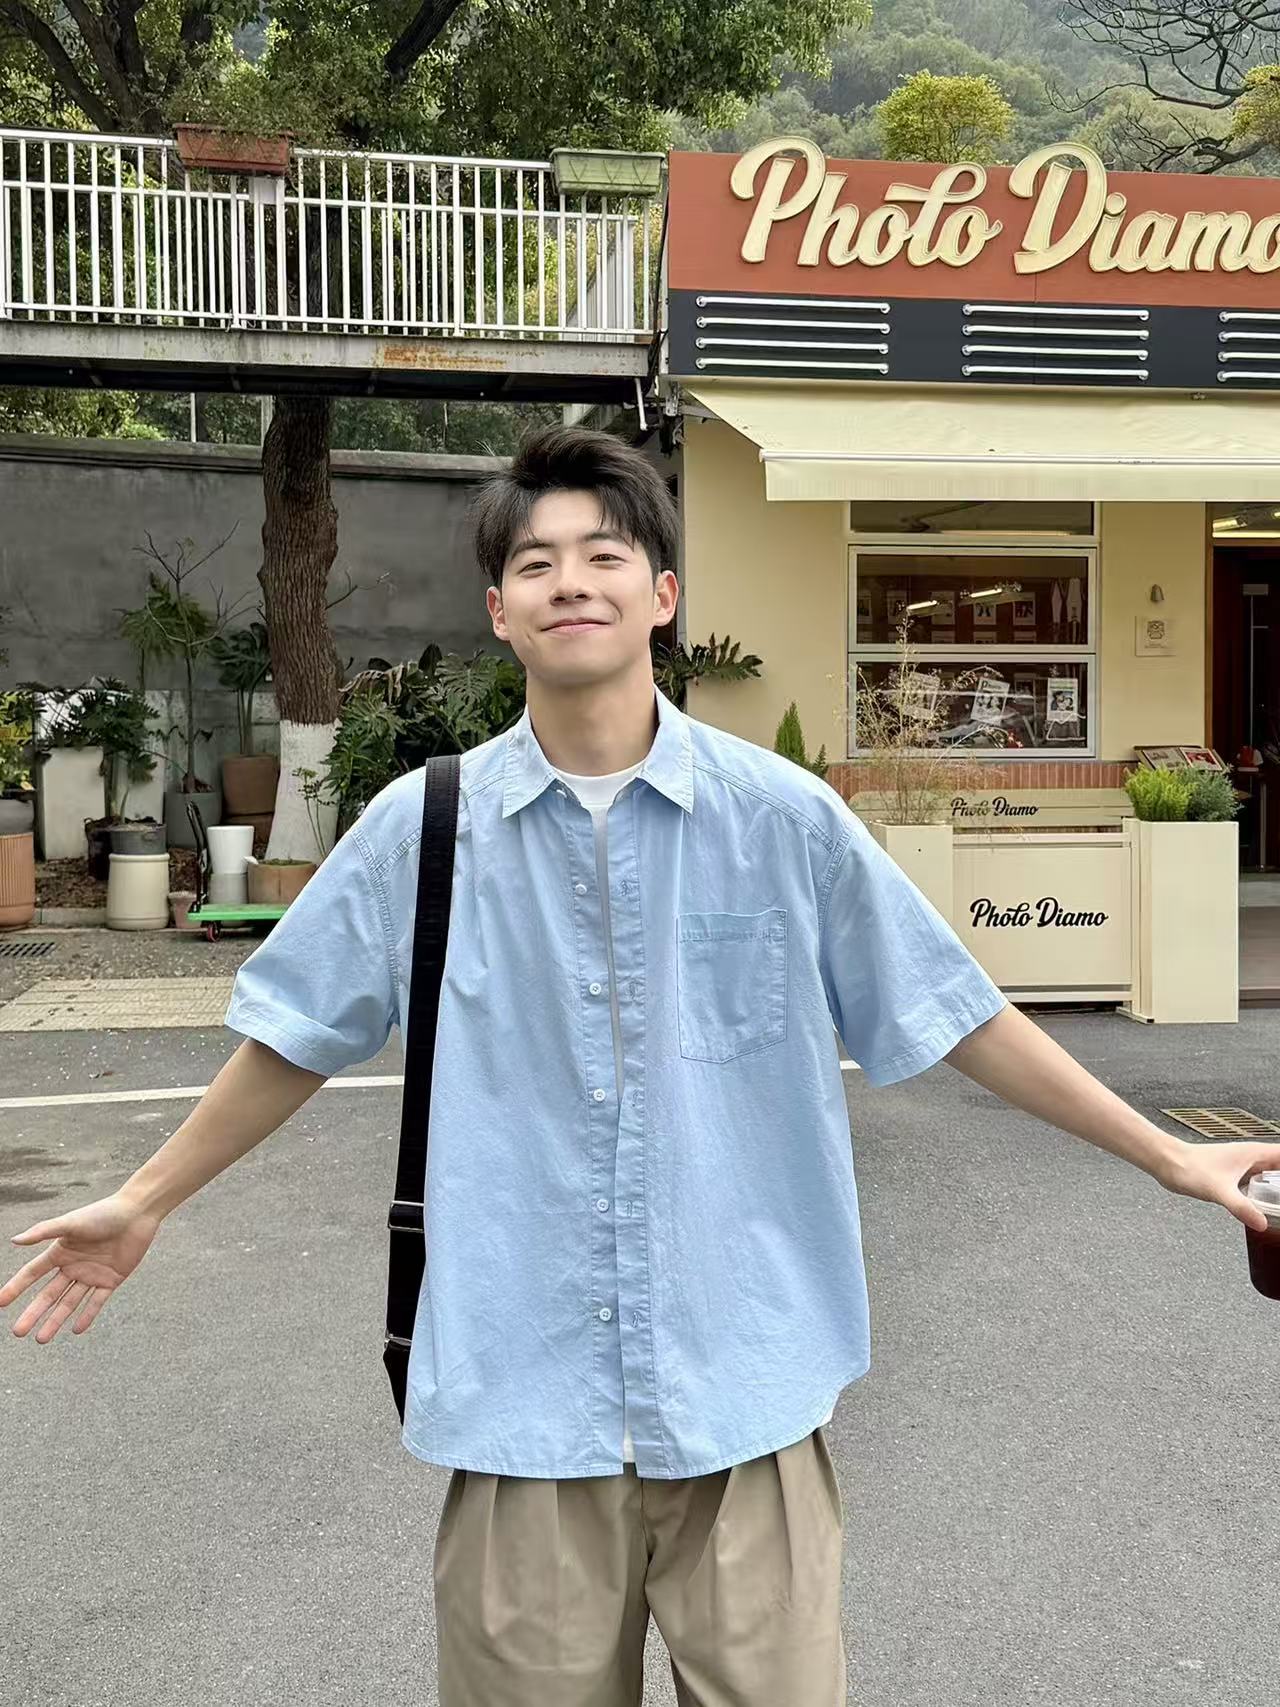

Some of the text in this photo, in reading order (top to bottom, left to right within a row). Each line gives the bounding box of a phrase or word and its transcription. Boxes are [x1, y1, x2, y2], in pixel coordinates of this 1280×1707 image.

[730, 136, 1003, 267] Photo
[950, 796, 1039, 816] Photo Diamo
[970, 897, 1109, 928] Photo Diamo
